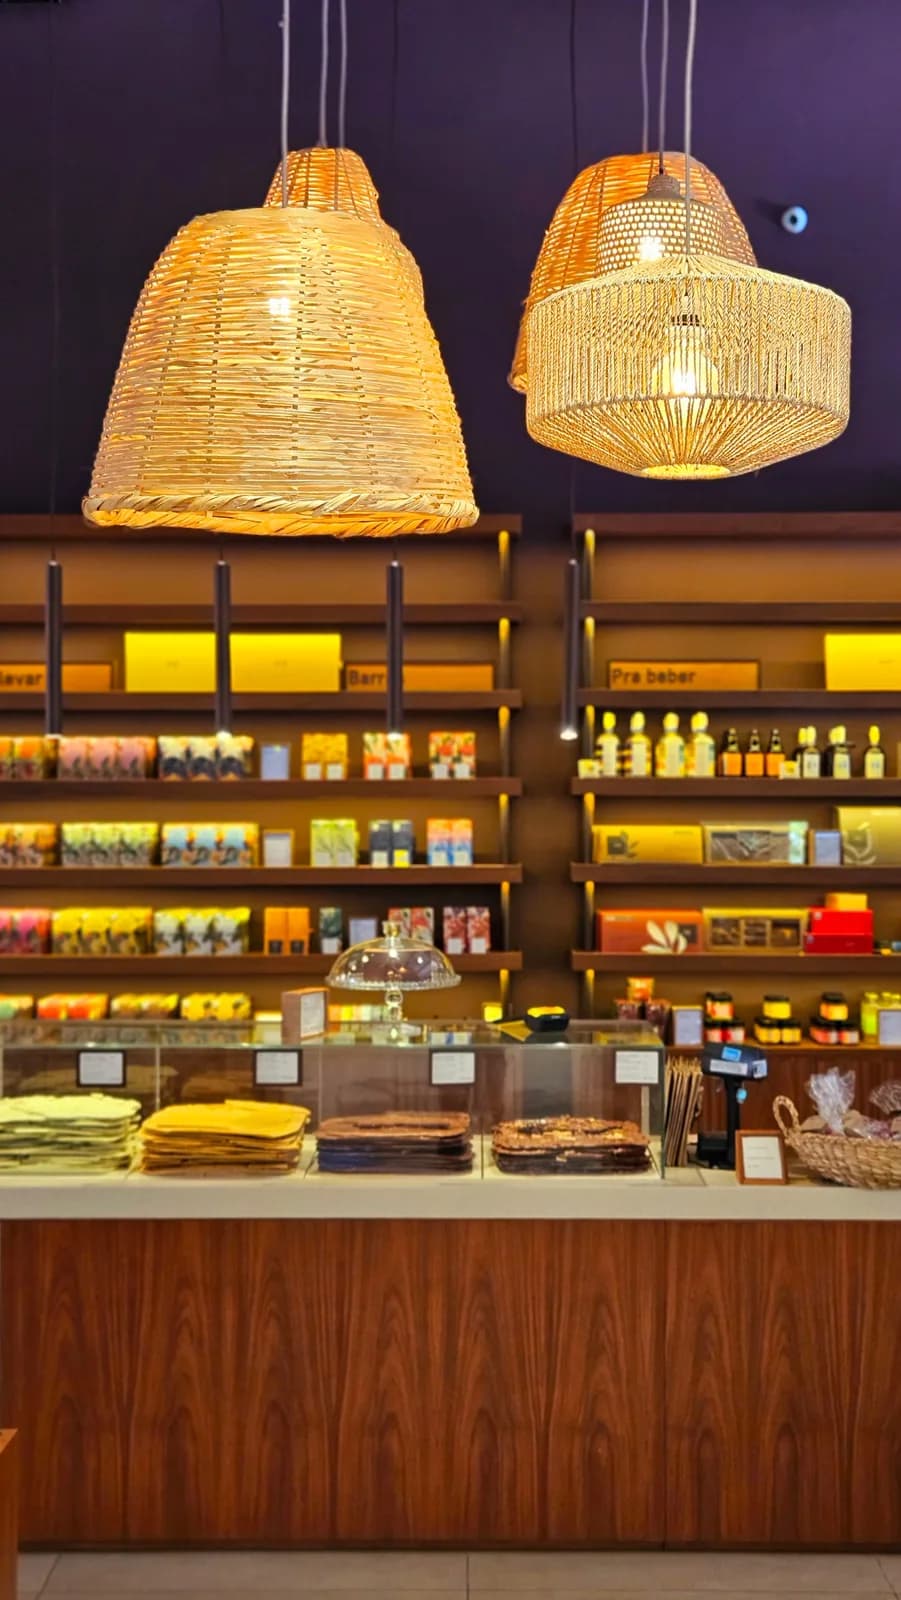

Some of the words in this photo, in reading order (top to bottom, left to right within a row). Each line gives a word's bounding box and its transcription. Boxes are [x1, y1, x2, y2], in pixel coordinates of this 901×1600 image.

[349, 670, 403, 686] Barr
[611, 667, 641, 685] Pra
[646, 667, 697, 685] beber
